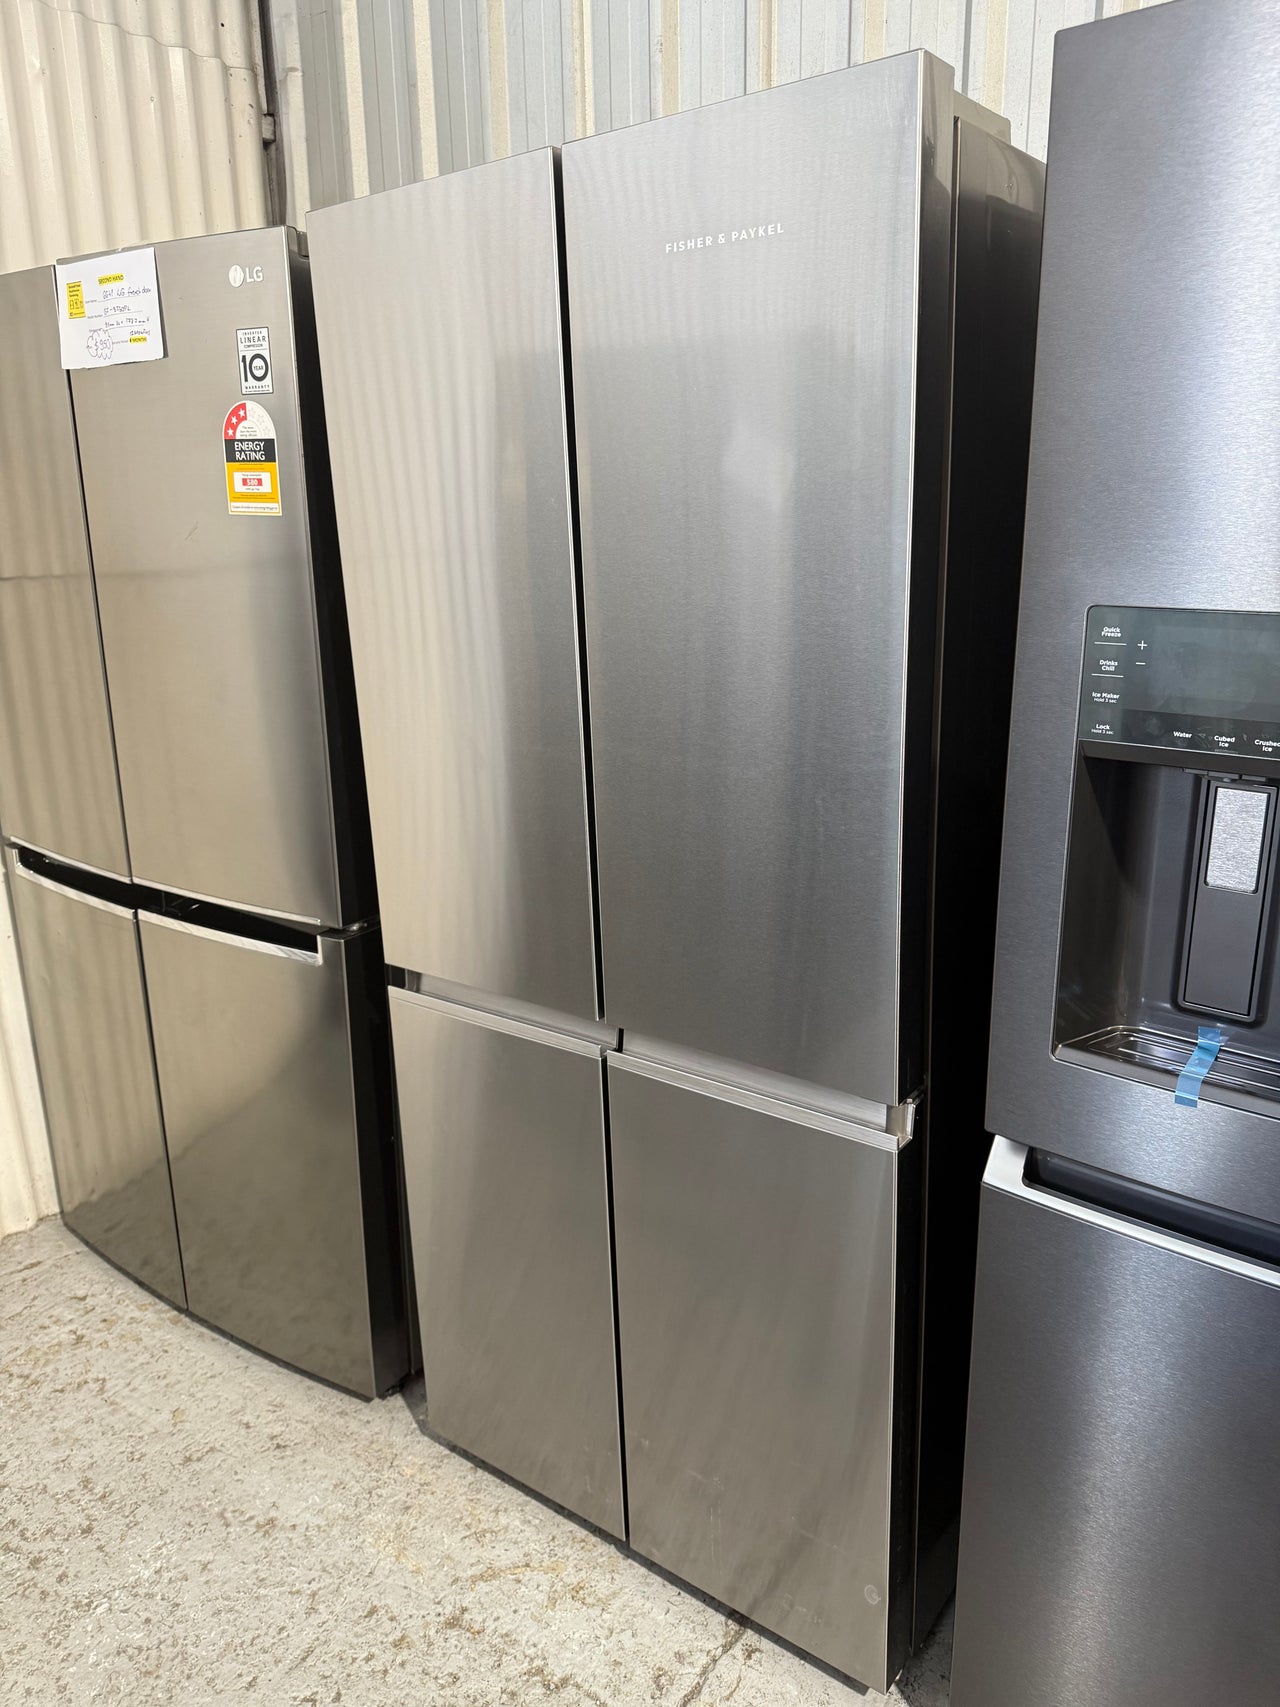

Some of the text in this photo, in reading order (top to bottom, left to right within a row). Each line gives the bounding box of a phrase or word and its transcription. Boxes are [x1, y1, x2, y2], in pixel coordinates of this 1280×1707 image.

[665, 223, 784, 254] FISHER & PAYKEL
[246, 266, 264, 283] LG
[240, 336, 267, 344] LINEAR
[241, 353, 269, 382] 10
[234, 441, 265, 451] ENERGY
[235, 451, 266, 461] RATING
[1214, 735, 1235, 743] Cubed
